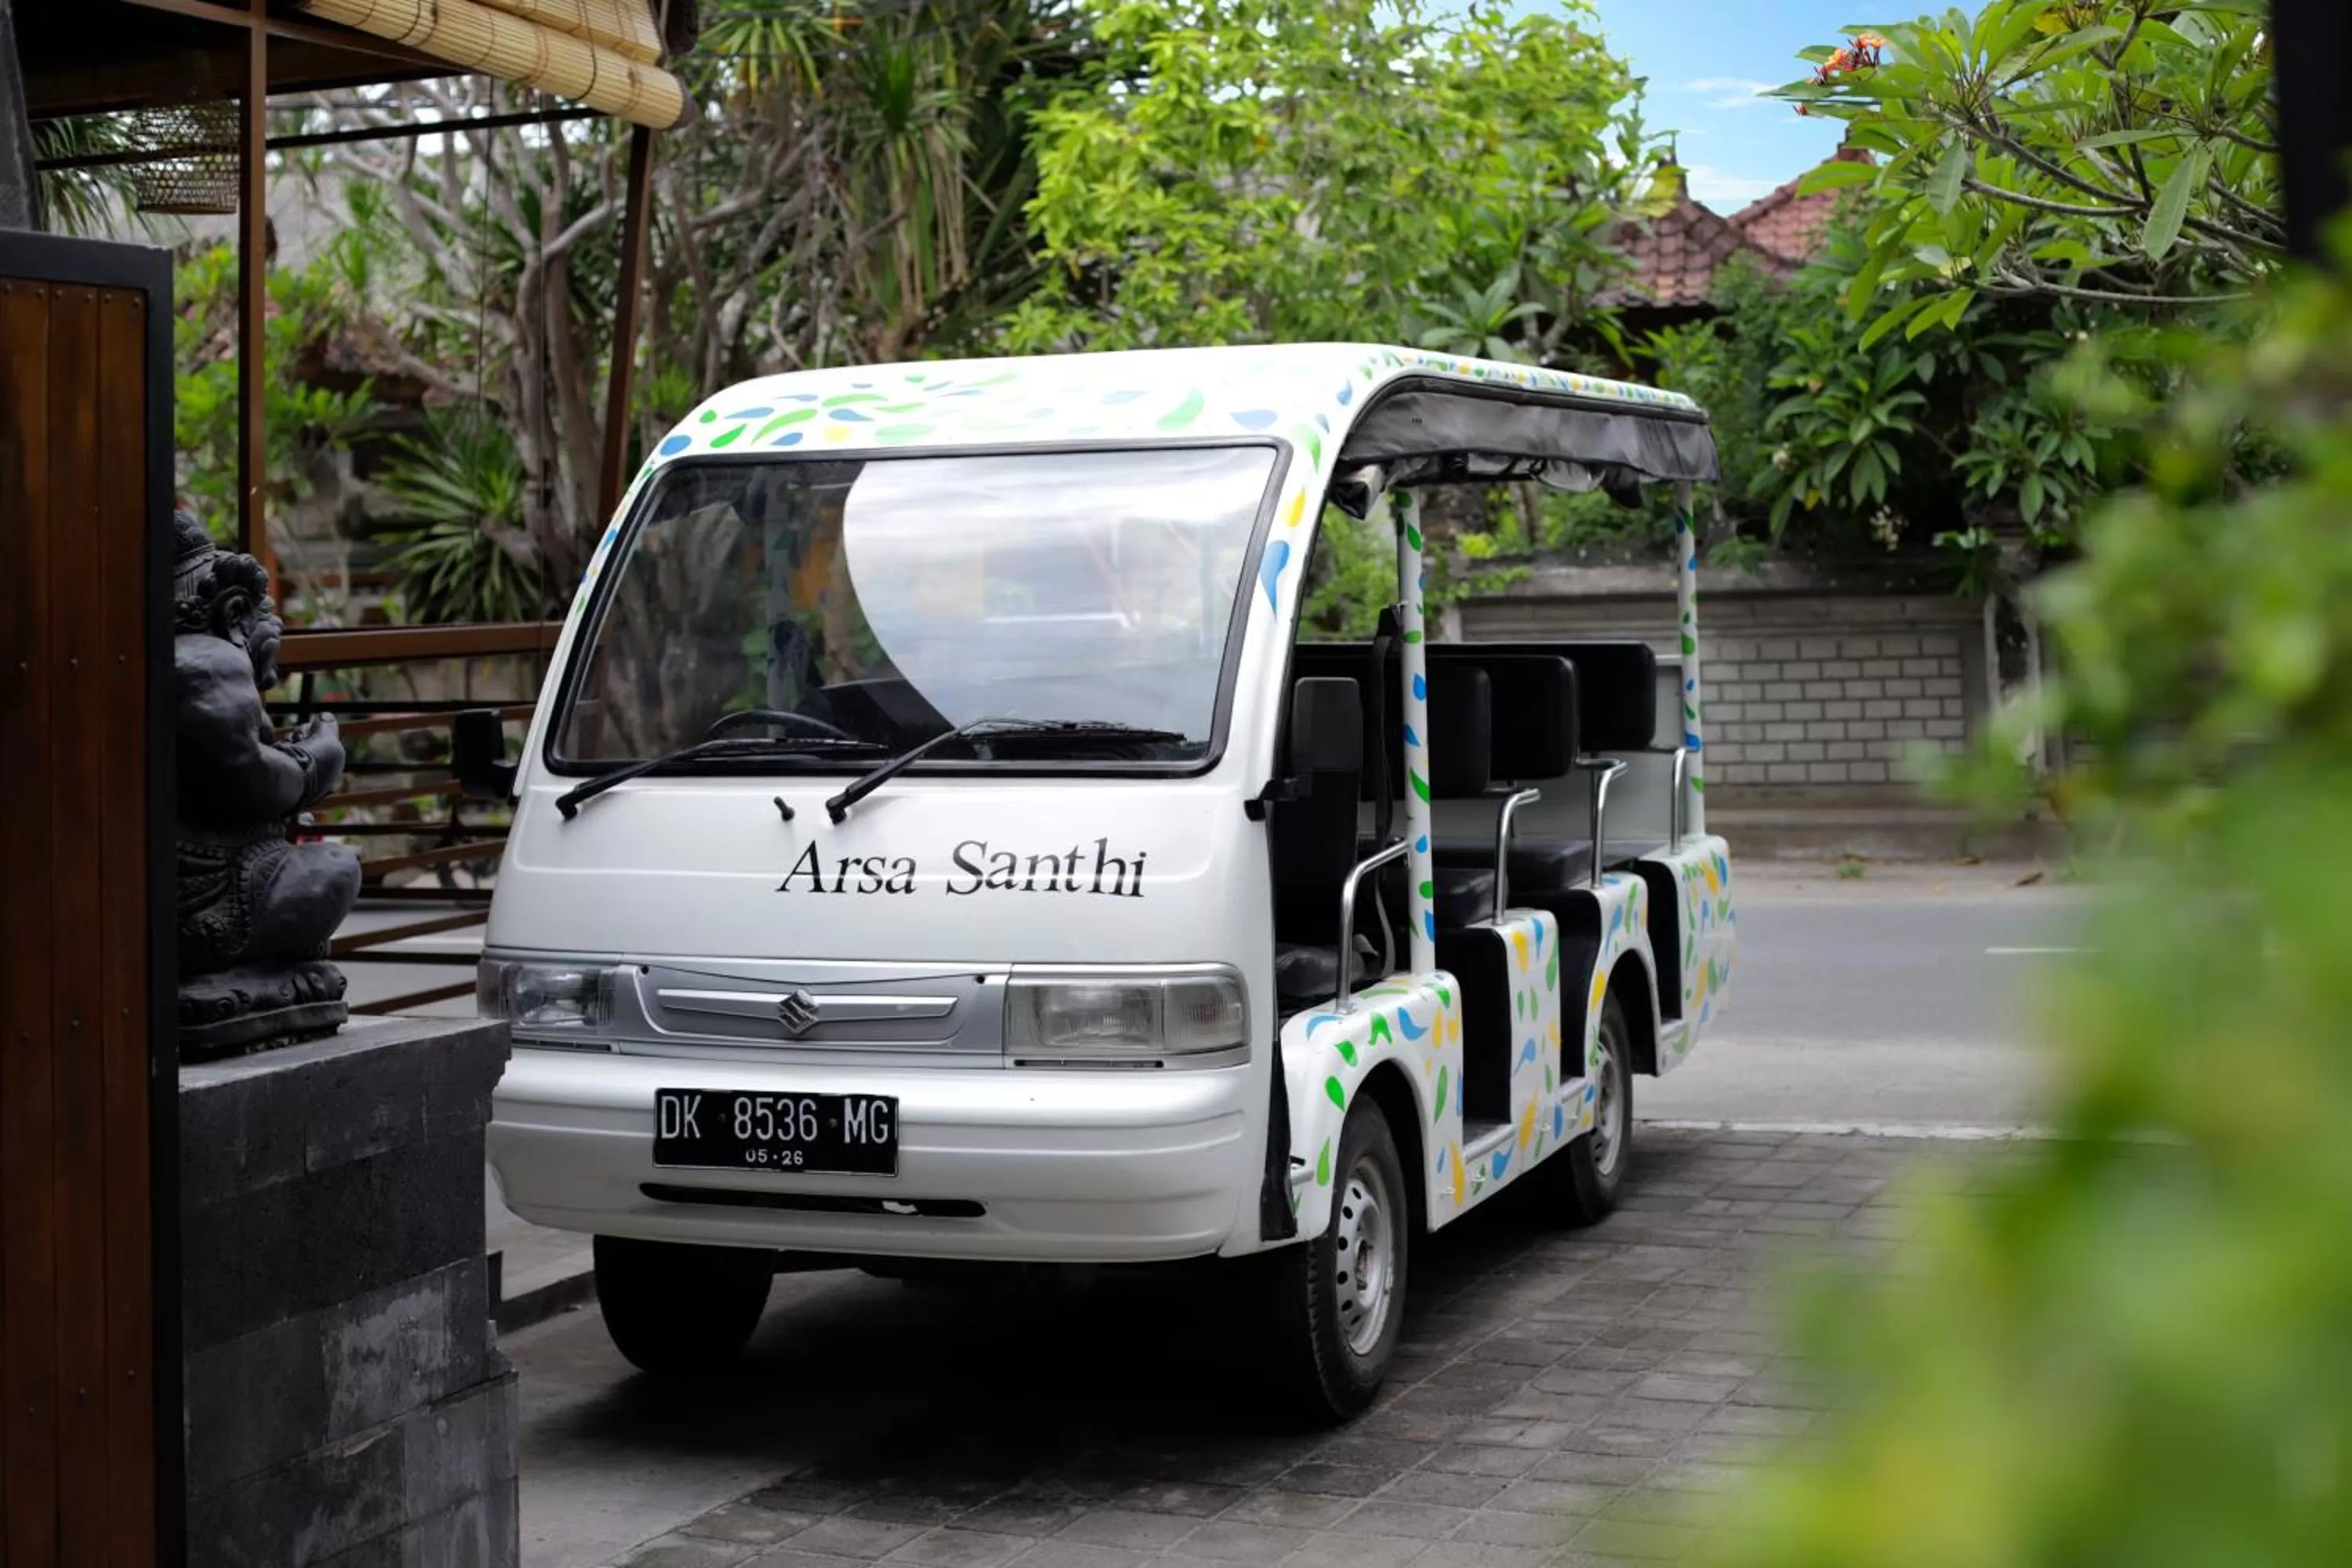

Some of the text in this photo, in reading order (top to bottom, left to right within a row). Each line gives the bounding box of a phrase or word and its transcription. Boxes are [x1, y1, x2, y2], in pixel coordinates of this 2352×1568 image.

[776, 837, 1147, 898] Arsa Santhi
[661, 1095, 889, 1145] DK 8536 MG
